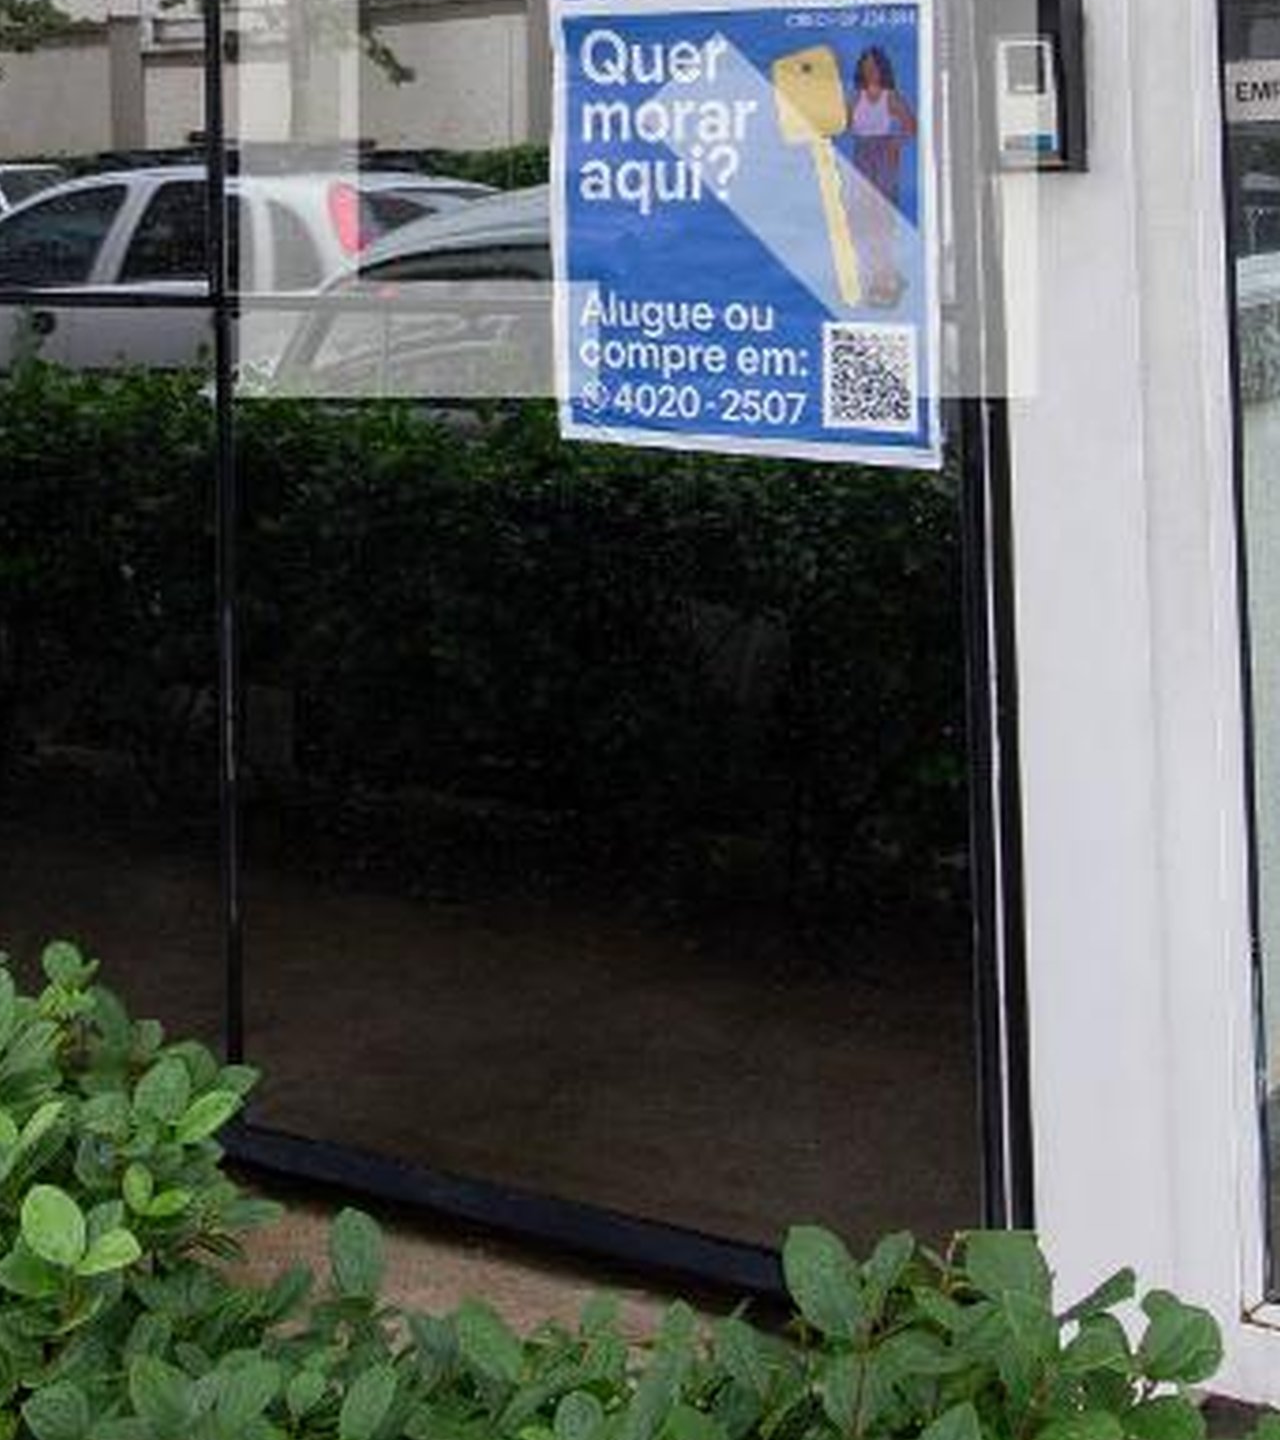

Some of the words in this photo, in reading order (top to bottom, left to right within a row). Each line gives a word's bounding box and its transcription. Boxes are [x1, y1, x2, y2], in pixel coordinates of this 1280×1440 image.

[580, 29, 728, 86] Quer
[583, 99, 758, 143] morar
[580, 144, 739, 215] aqui?
[580, 289, 714, 337] Alugue
[724, 302, 773, 331] ou
[579, 339, 727, 379] compre
[736, 345, 809, 377] em:
